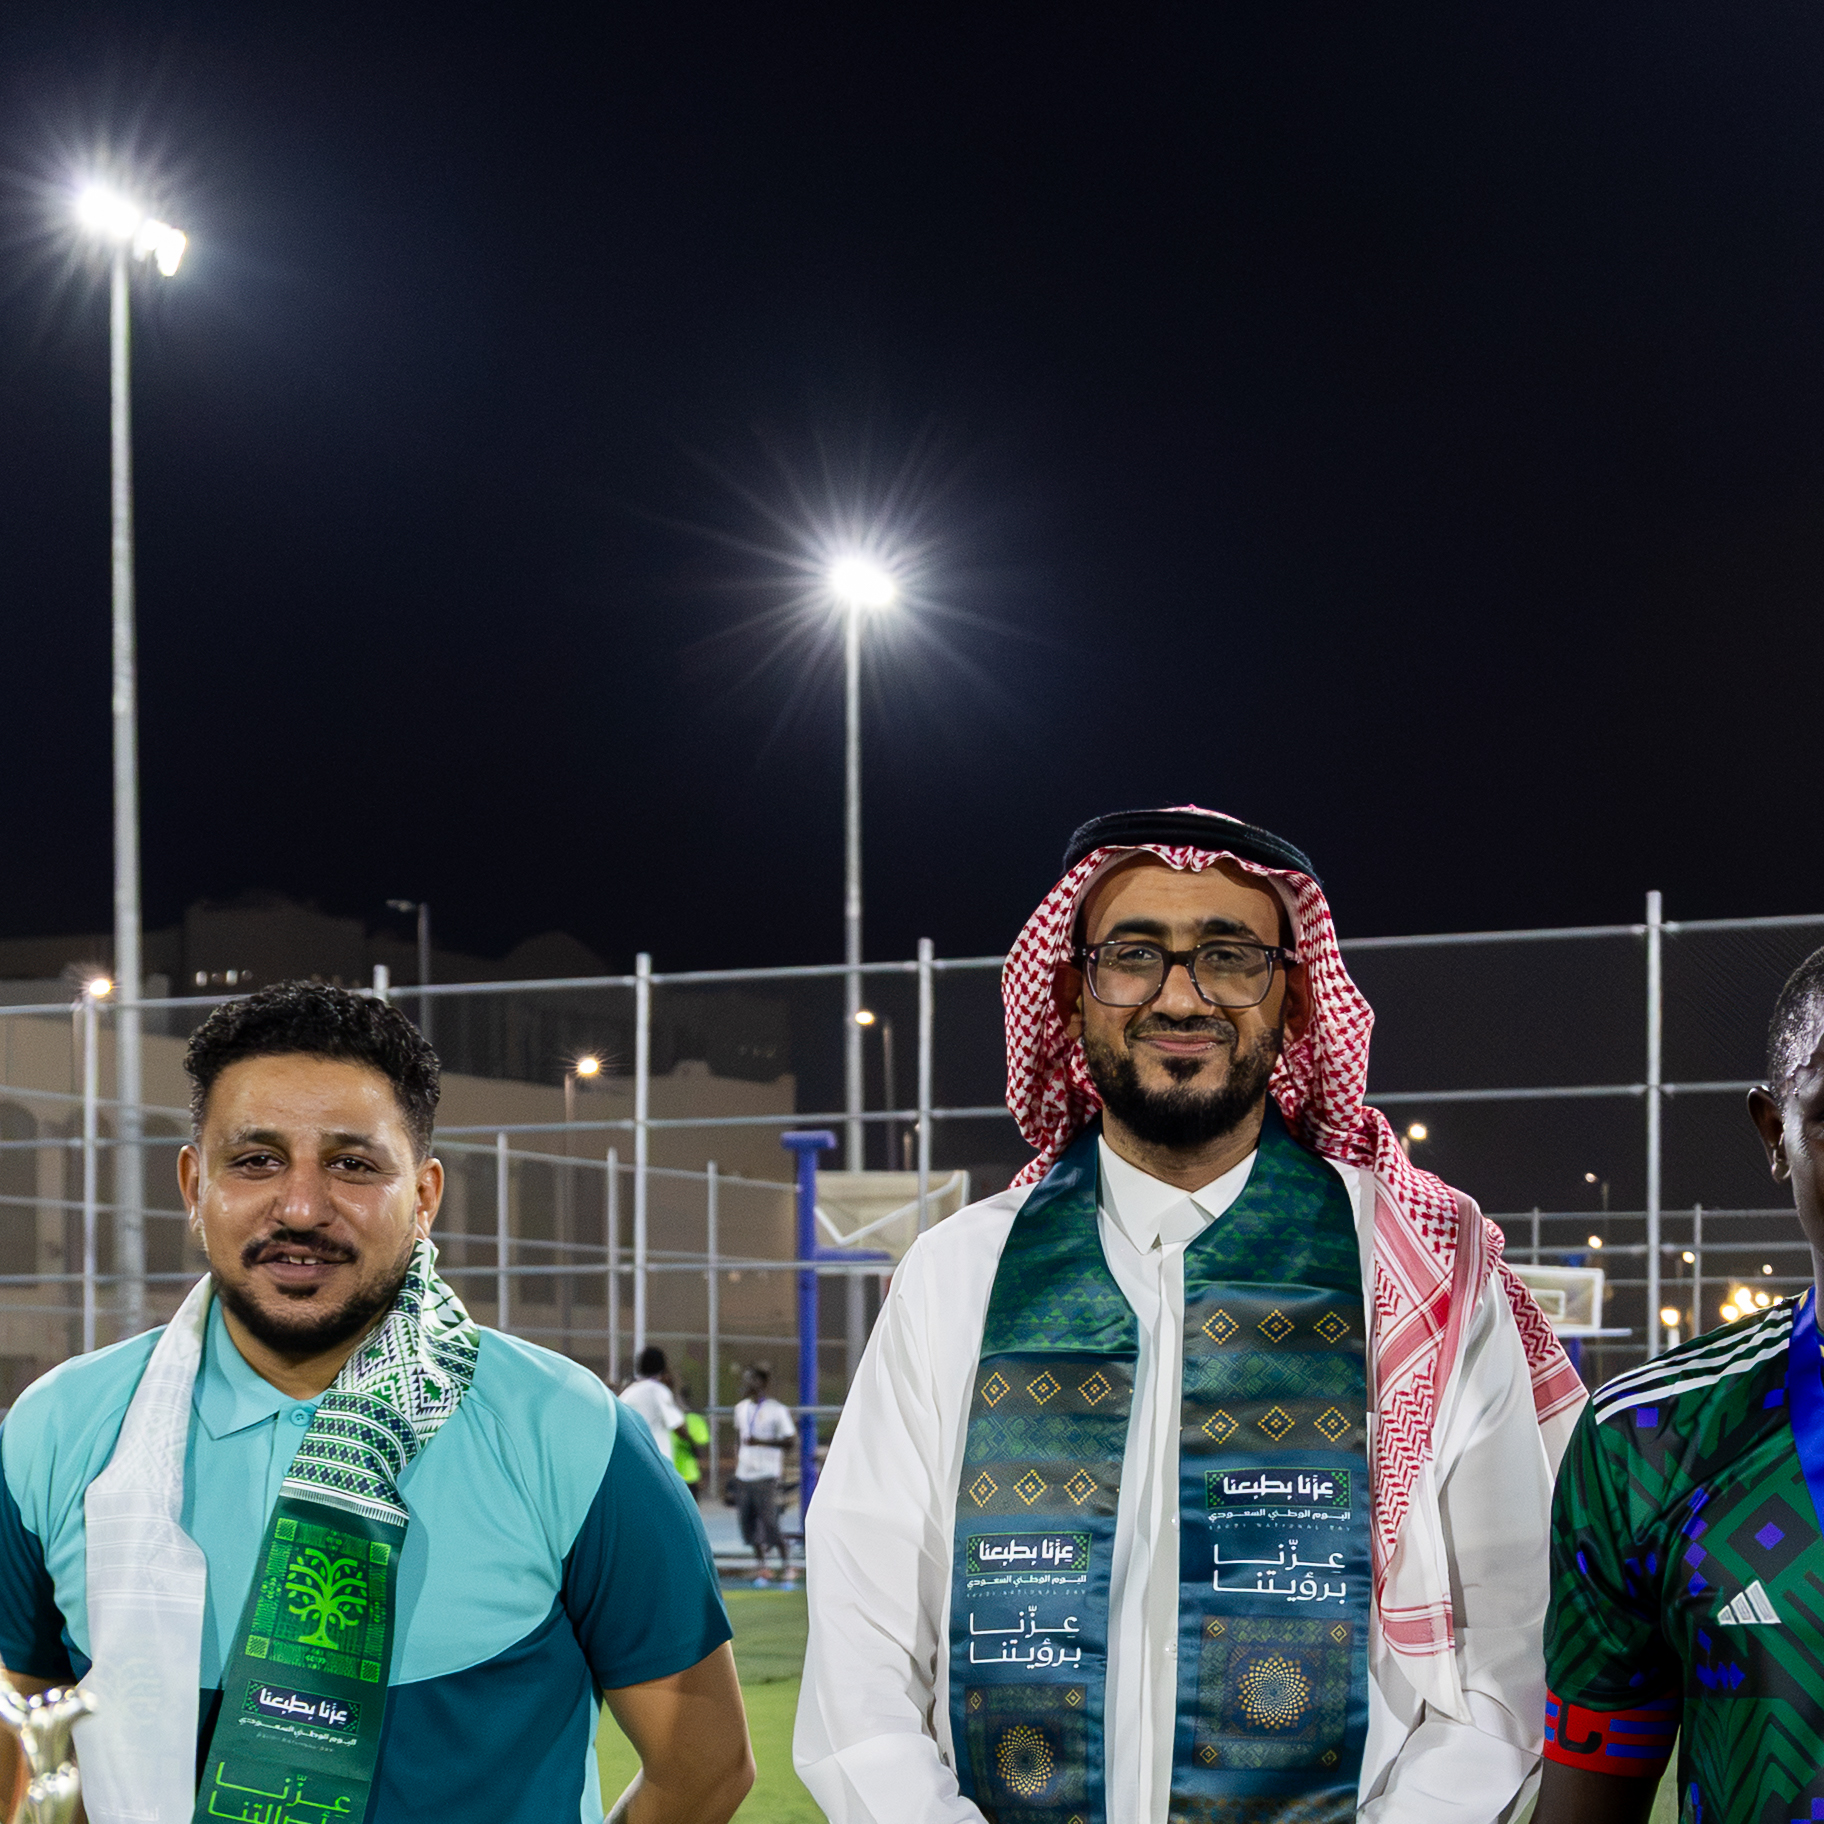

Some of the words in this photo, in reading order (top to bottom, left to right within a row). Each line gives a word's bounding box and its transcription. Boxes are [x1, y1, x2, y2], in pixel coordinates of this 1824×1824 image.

[1223, 1474, 1293, 1500] بطبعنا
[979, 1539, 1037, 1567] بطبعنا
[1212, 1569, 1347, 1605] برؤيتنا
[969, 1637, 1082, 1670] برؤيتنا
[259, 1687, 316, 1721] بطبعنا
